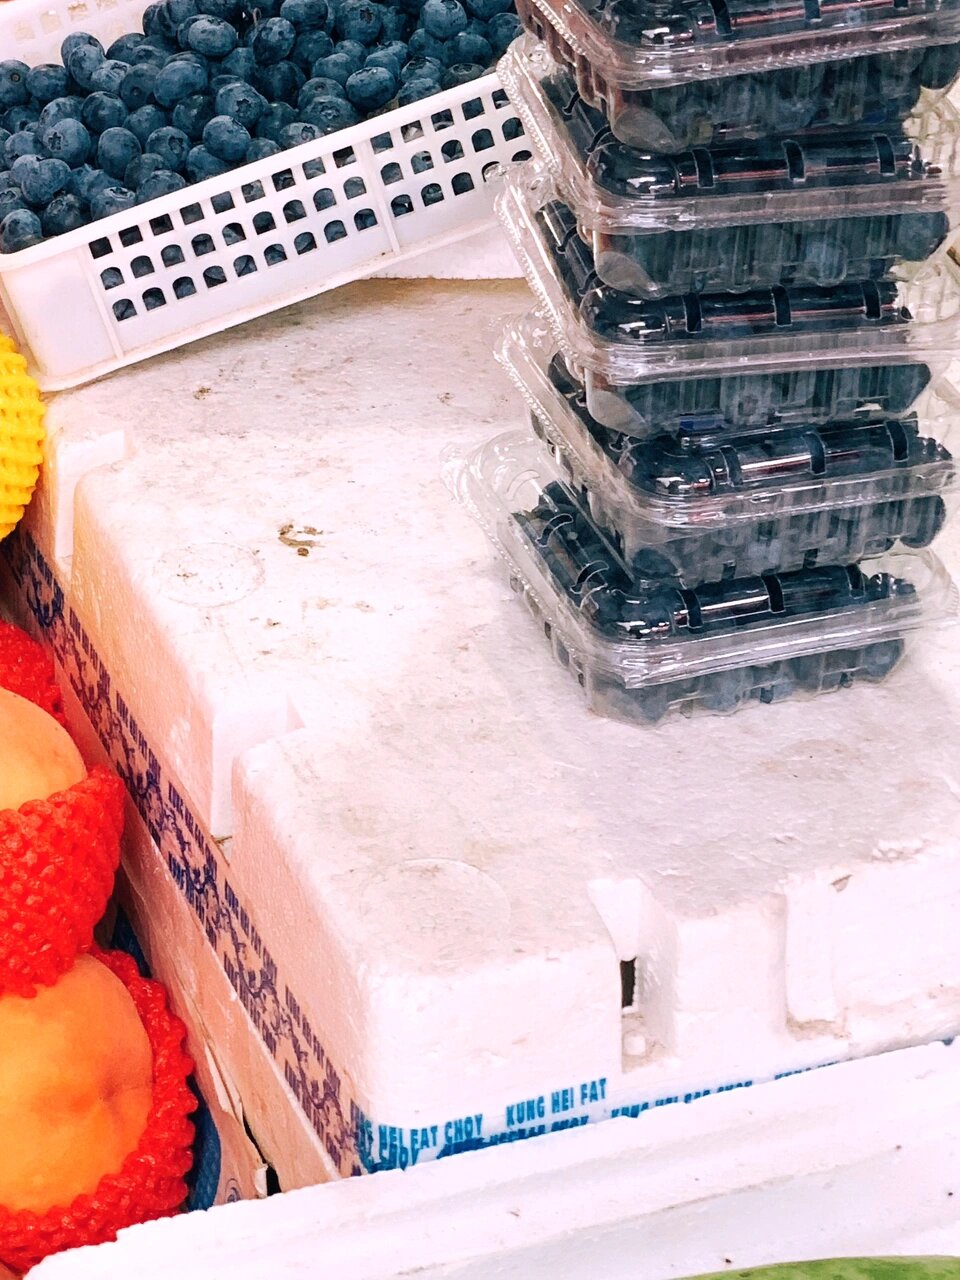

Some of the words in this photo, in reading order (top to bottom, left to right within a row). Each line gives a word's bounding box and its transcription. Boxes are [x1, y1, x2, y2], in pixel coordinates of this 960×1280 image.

[378, 1124, 403, 1149] HEI
[410, 1125, 438, 1150] FAT
[444, 1113, 483, 1144] CHOY
[506, 1096, 545, 1127] KUNG
[551, 1087, 574, 1114] HEI
[580, 1077, 607, 1106] FAT
